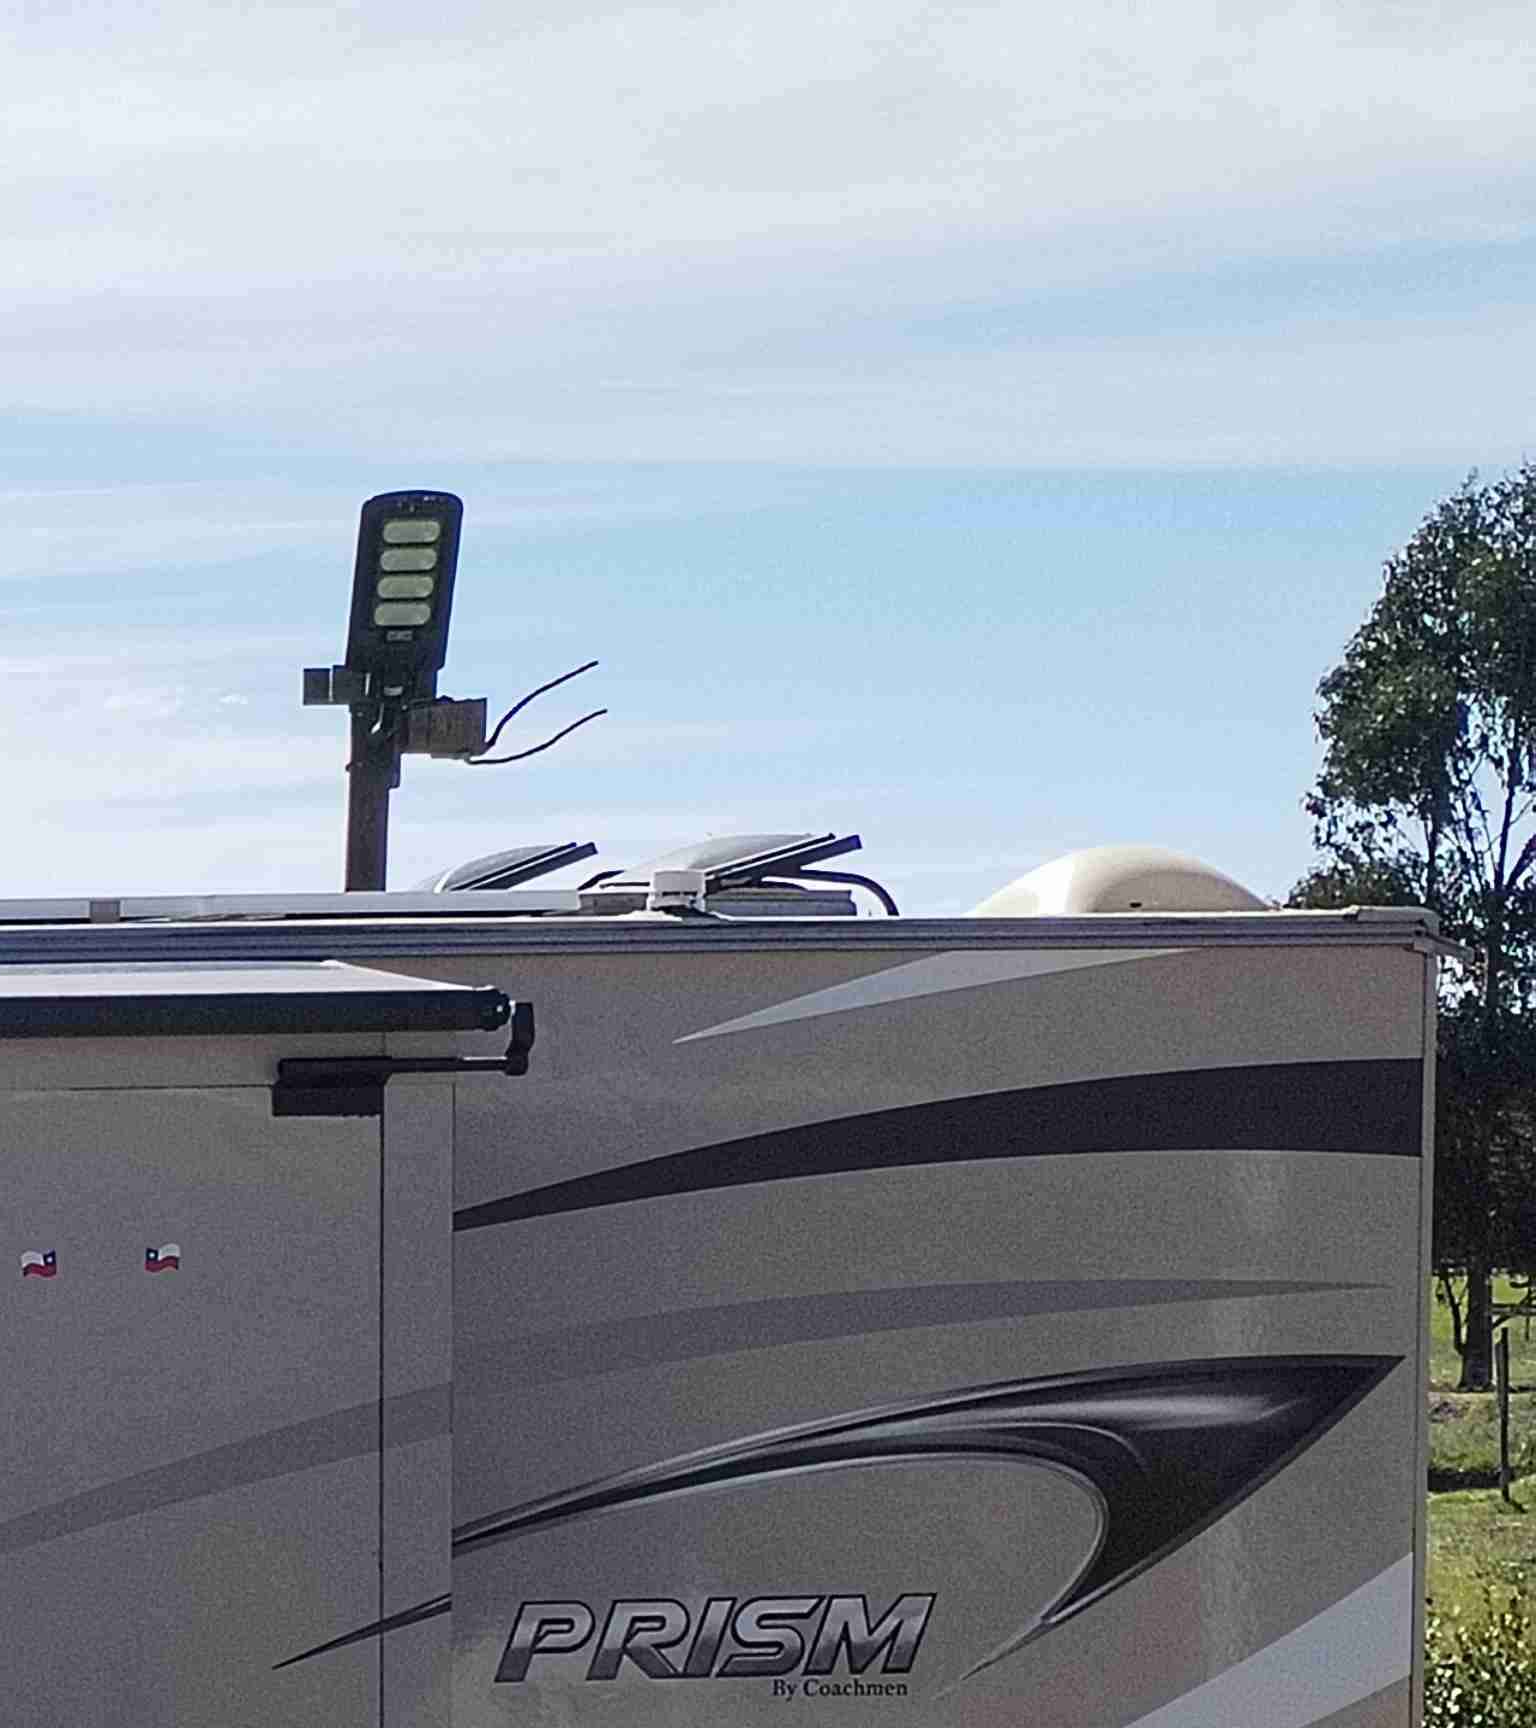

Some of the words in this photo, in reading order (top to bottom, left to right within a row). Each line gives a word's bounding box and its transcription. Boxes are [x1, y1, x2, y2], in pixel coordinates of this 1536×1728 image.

[493, 1593, 937, 1682] PRISM
[773, 1679, 798, 1702] By
[803, 1678, 908, 1697] Coachmen
